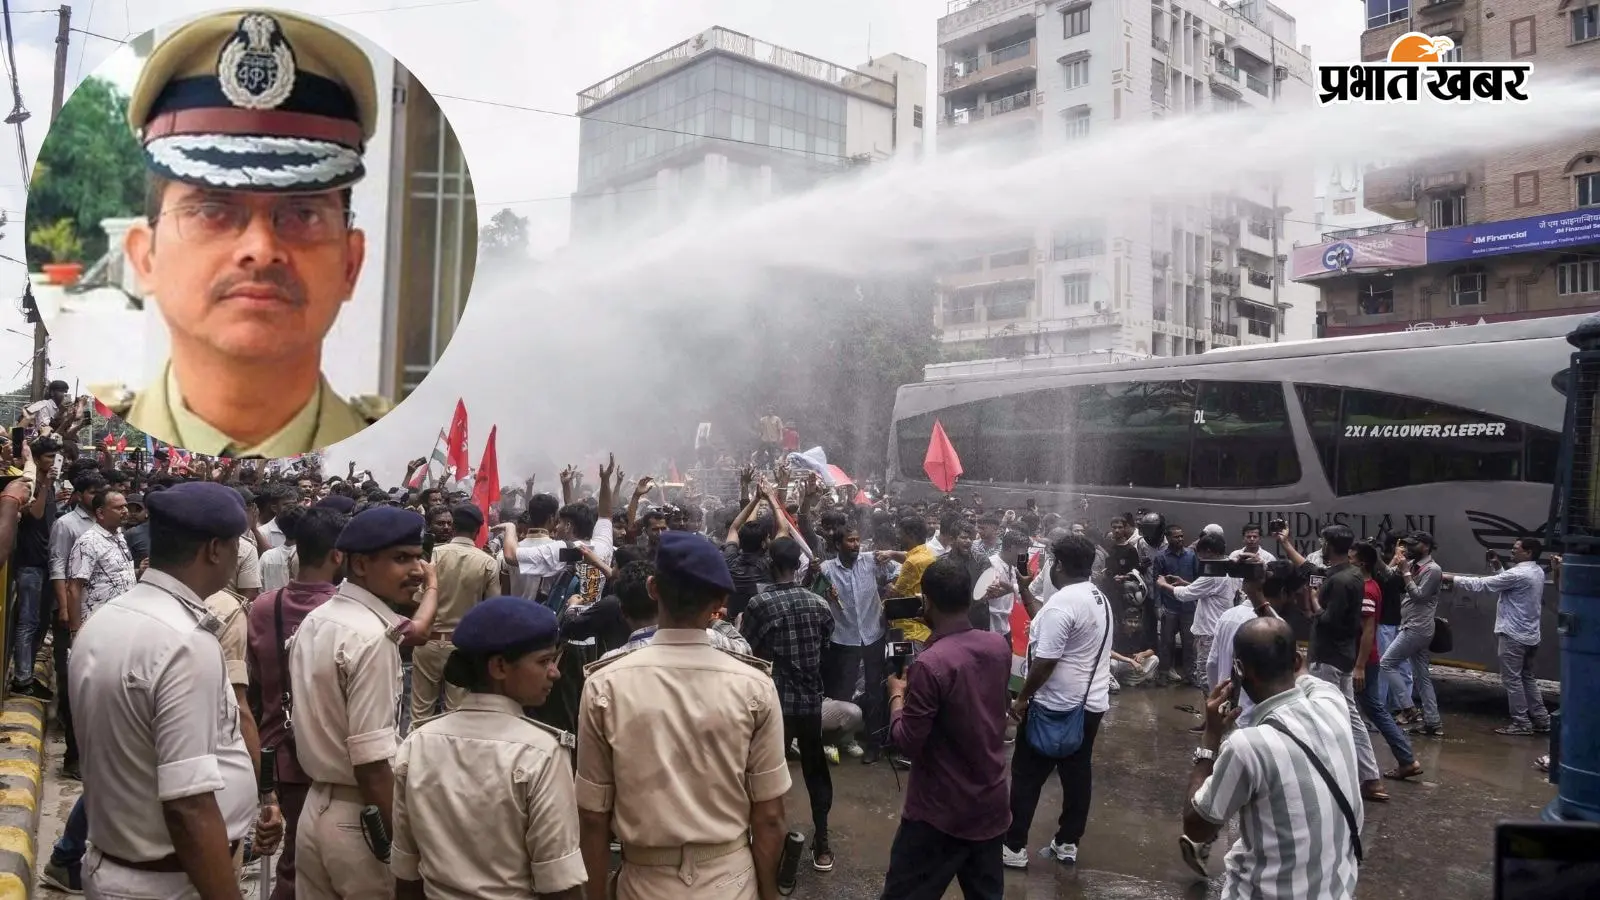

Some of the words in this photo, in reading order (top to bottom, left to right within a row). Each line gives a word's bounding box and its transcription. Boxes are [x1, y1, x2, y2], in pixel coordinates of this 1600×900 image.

[1565, 224, 1592, 233] Financial
[1473, 236, 1486, 244] JM
[1486, 230, 1527, 242] Financial
[1344, 425, 1367, 438] 2X1
[1441, 422, 1506, 438] SLEEPER
